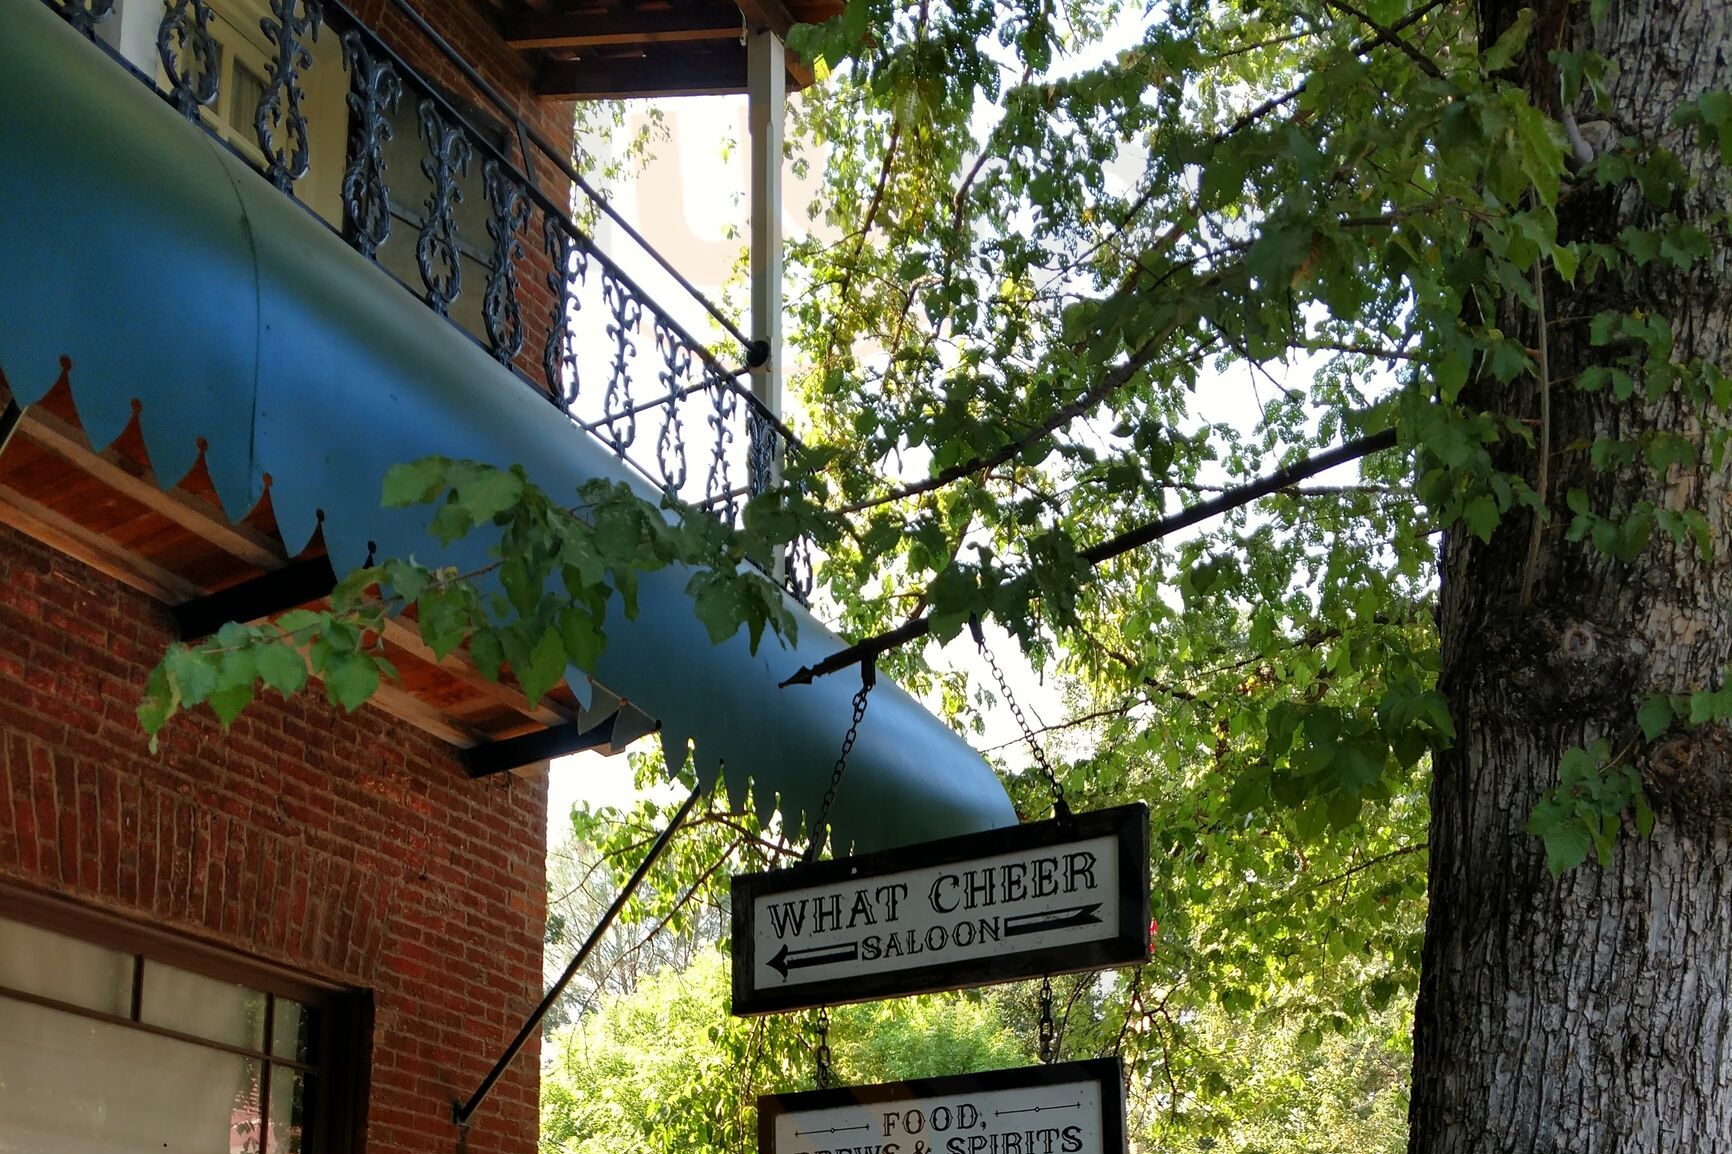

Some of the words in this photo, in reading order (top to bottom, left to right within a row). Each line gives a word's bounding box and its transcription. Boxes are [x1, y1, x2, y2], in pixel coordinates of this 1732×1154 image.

[767, 883, 908, 939] WHAT
[928, 851, 1097, 914] CHEER
[861, 916, 1000, 962] SALOON
